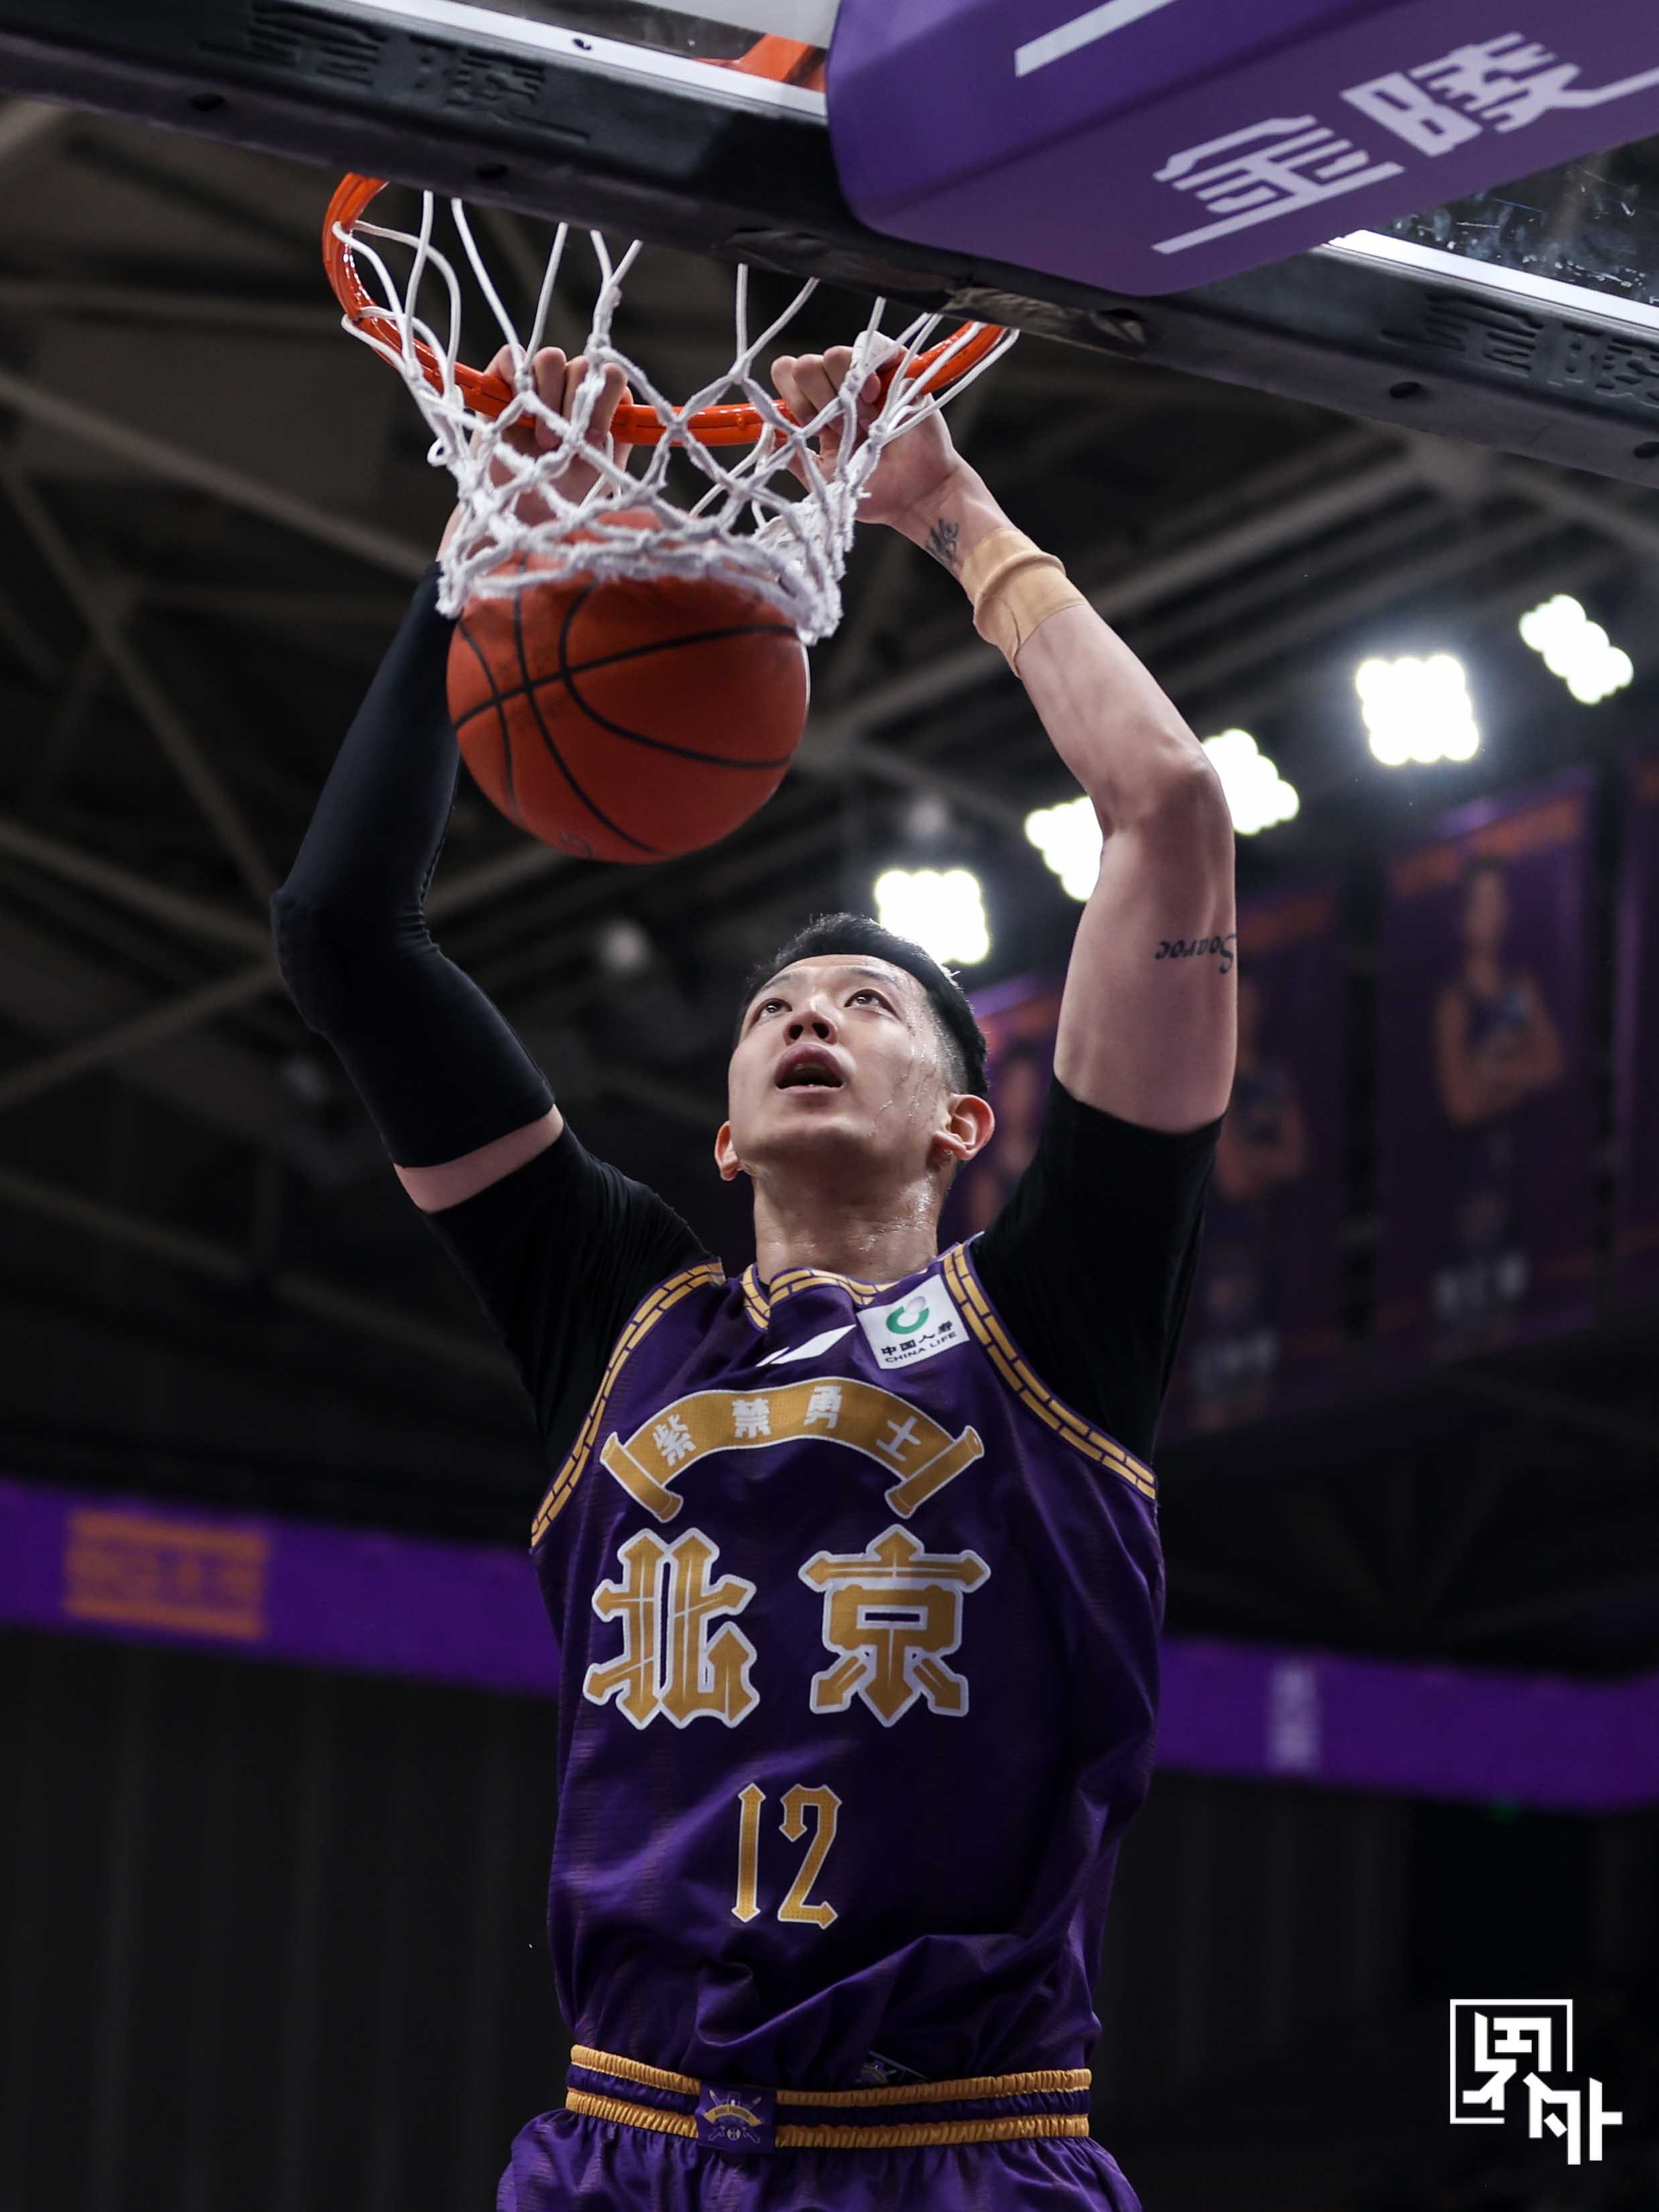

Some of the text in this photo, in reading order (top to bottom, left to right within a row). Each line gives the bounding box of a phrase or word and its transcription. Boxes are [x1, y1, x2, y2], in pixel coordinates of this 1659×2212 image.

[880, 1320, 953, 1356] 中国人寿
[885, 1331, 957, 1363] CHINA LIFE
[652, 1385, 922, 1468] 紫禁勇士
[582, 1524, 992, 1731] 北京
[731, 1782, 843, 1930] 12
